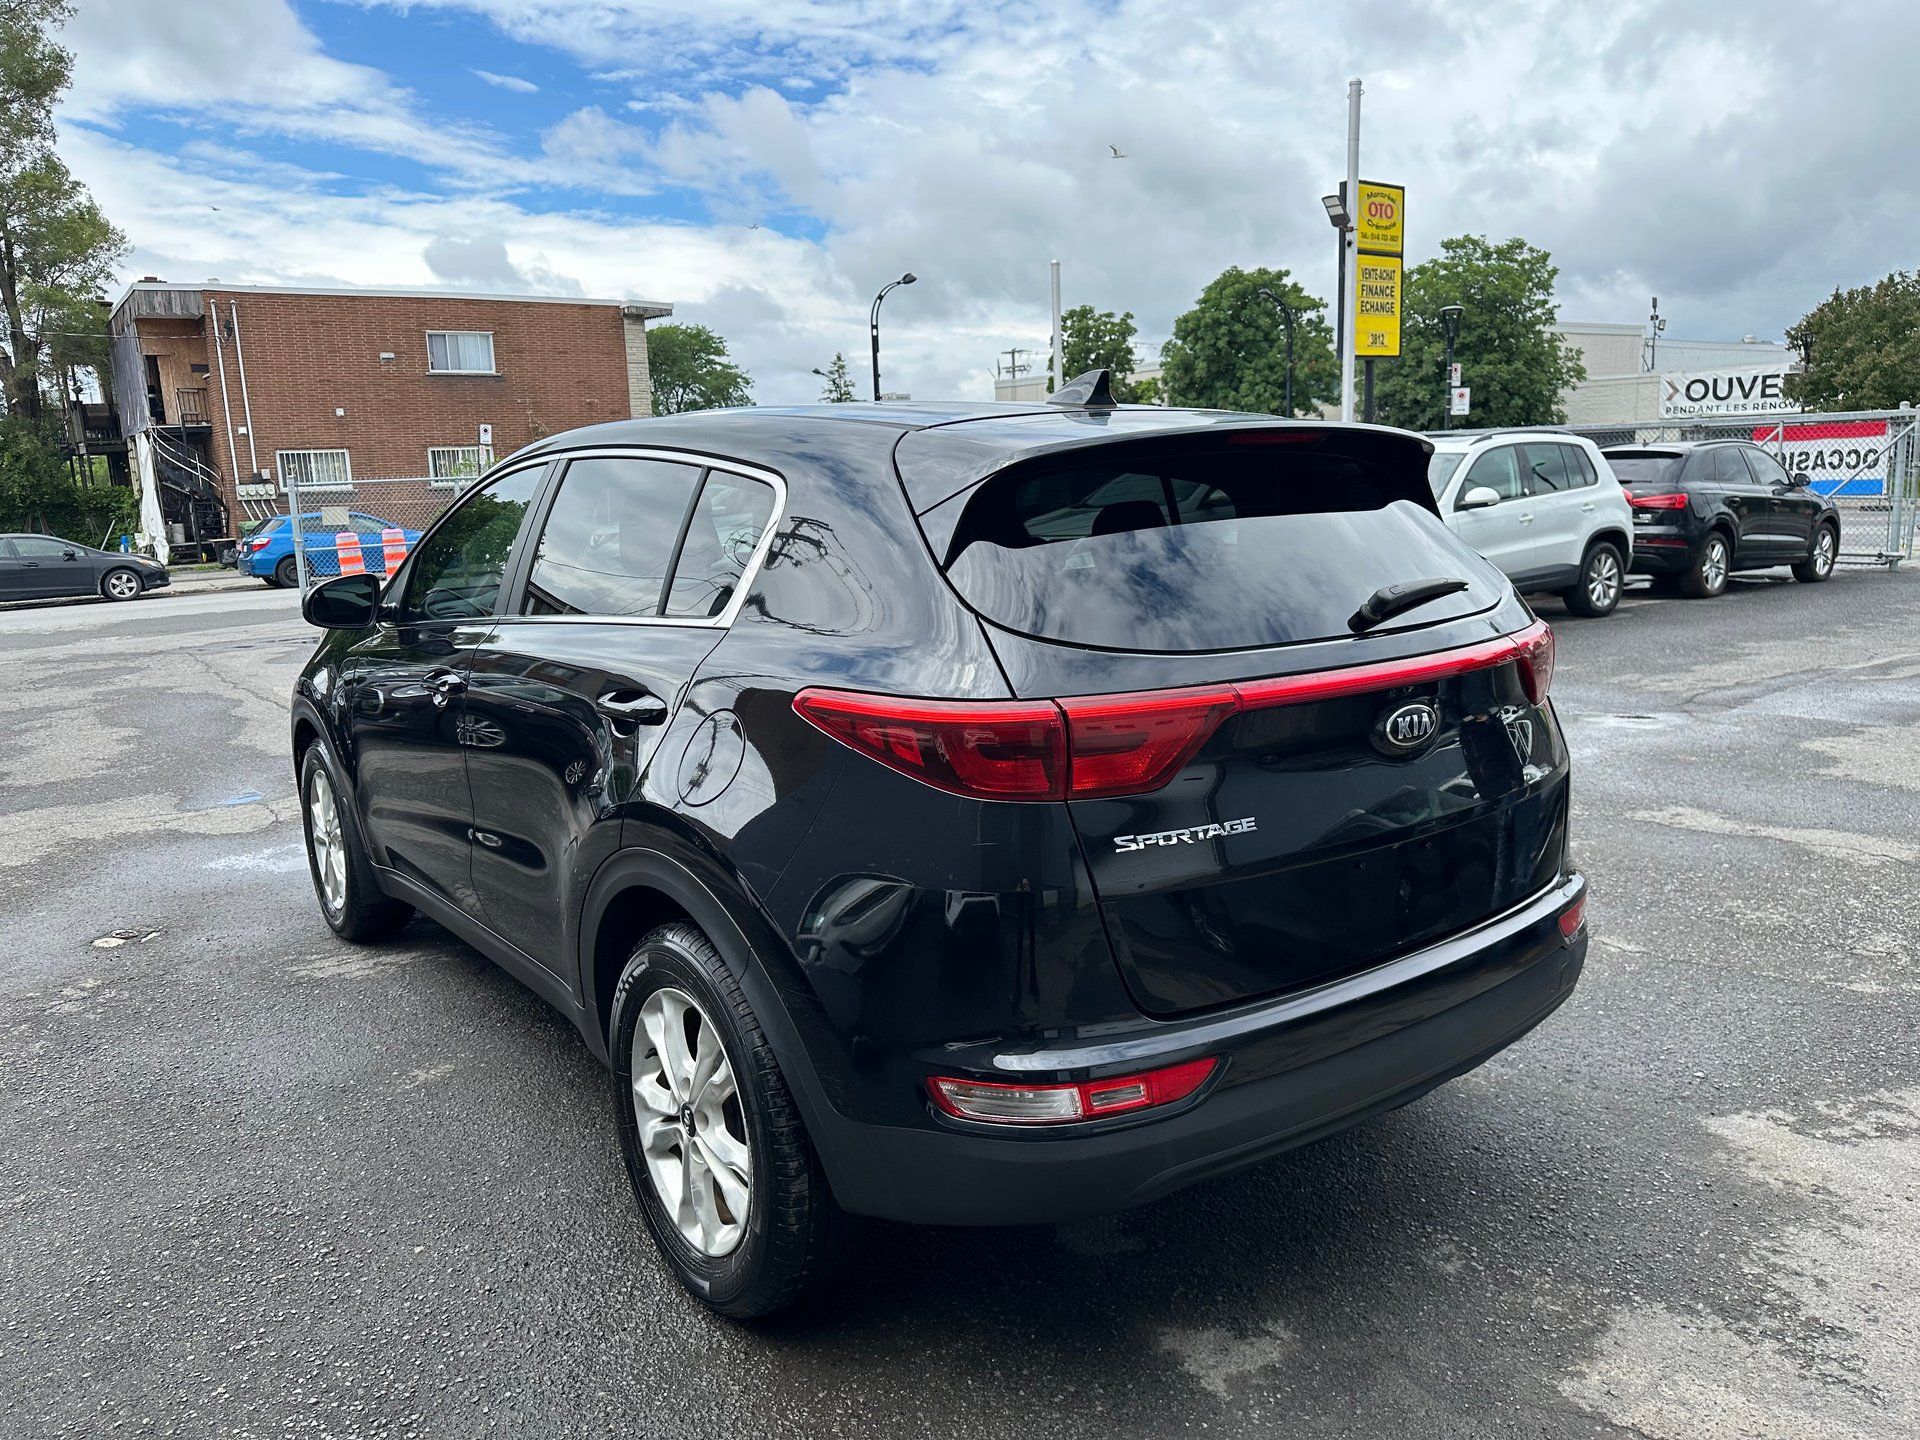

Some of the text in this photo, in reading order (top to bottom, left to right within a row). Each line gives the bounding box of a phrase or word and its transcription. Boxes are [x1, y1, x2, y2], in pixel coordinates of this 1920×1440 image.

[1368, 202, 1394, 219] OTO
[1361, 267, 1396, 281] VENTE-ACHAT
[1361, 284, 1395, 298] FINANCE
[1360, 300, 1395, 314] ECHANGE
[1370, 333, 1385, 345] 3812
[1684, 373, 1797, 402] OUVE
[1665, 403, 1721, 415] PENDANT
[1726, 401, 1748, 412] LES
[1396, 711, 1431, 740] KIA
[1113, 816, 1258, 853] SPORTAGE
